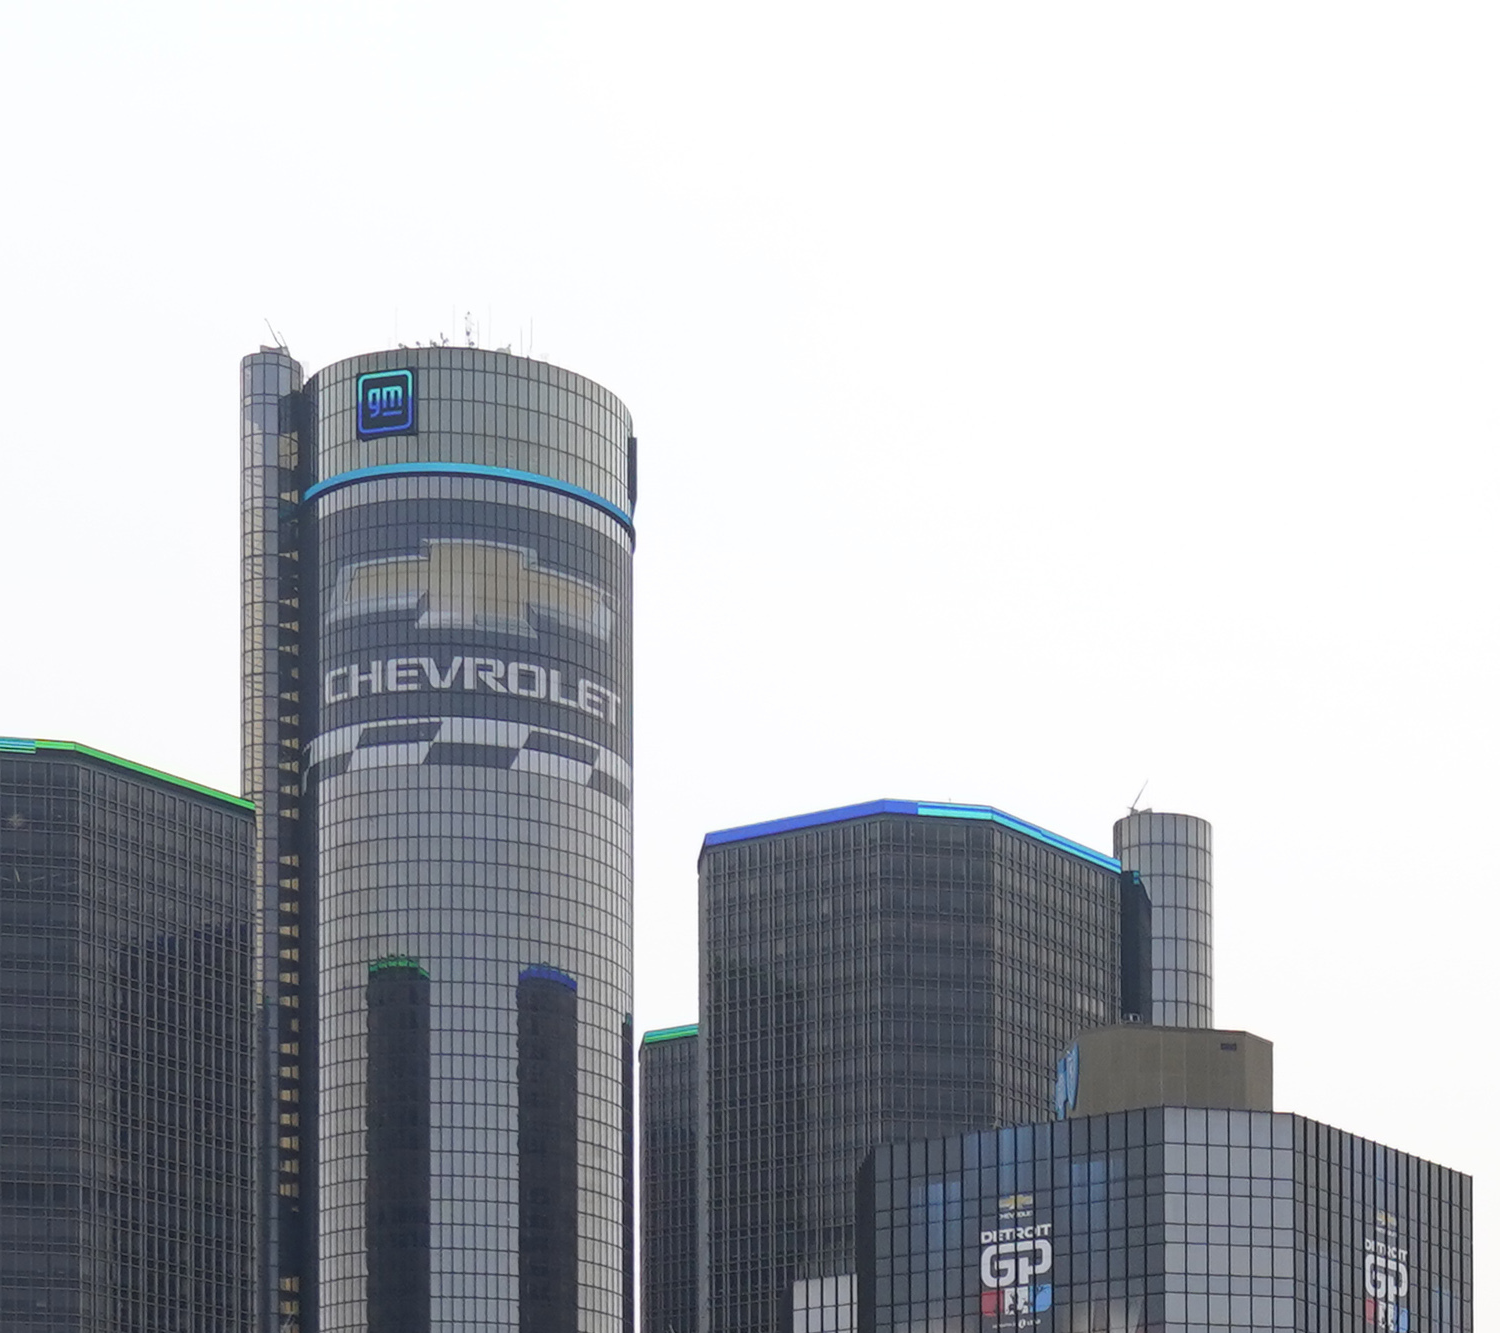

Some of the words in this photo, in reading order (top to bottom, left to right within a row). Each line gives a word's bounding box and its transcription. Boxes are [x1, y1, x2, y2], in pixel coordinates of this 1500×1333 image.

[367, 386, 404, 418] gm
[325, 656, 622, 726] CHEVROLET
[981, 1238, 1052, 1288] GP
